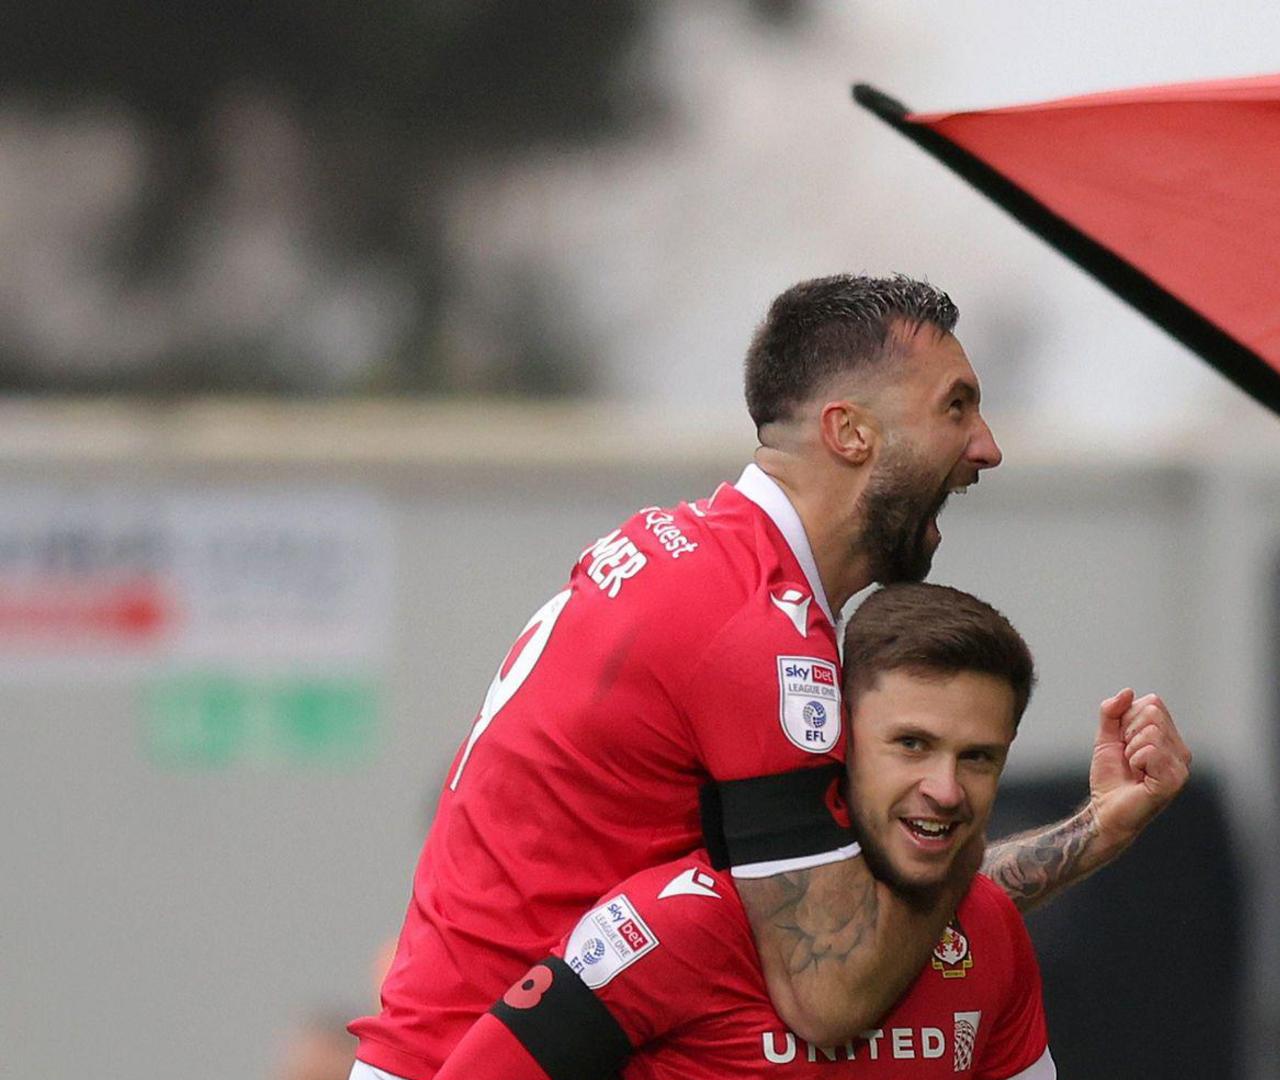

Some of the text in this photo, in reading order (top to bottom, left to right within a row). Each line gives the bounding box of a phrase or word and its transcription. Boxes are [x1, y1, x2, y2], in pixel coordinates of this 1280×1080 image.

[640, 506, 699, 558] Quest
[785, 664, 833, 683] sky bet
[450, 588, 572, 792] 9
[788, 683, 820, 695] LEAGUE
[805, 730, 826, 743] EFL
[607, 903, 644, 949] sky bet
[614, 940, 632, 958] ONE
